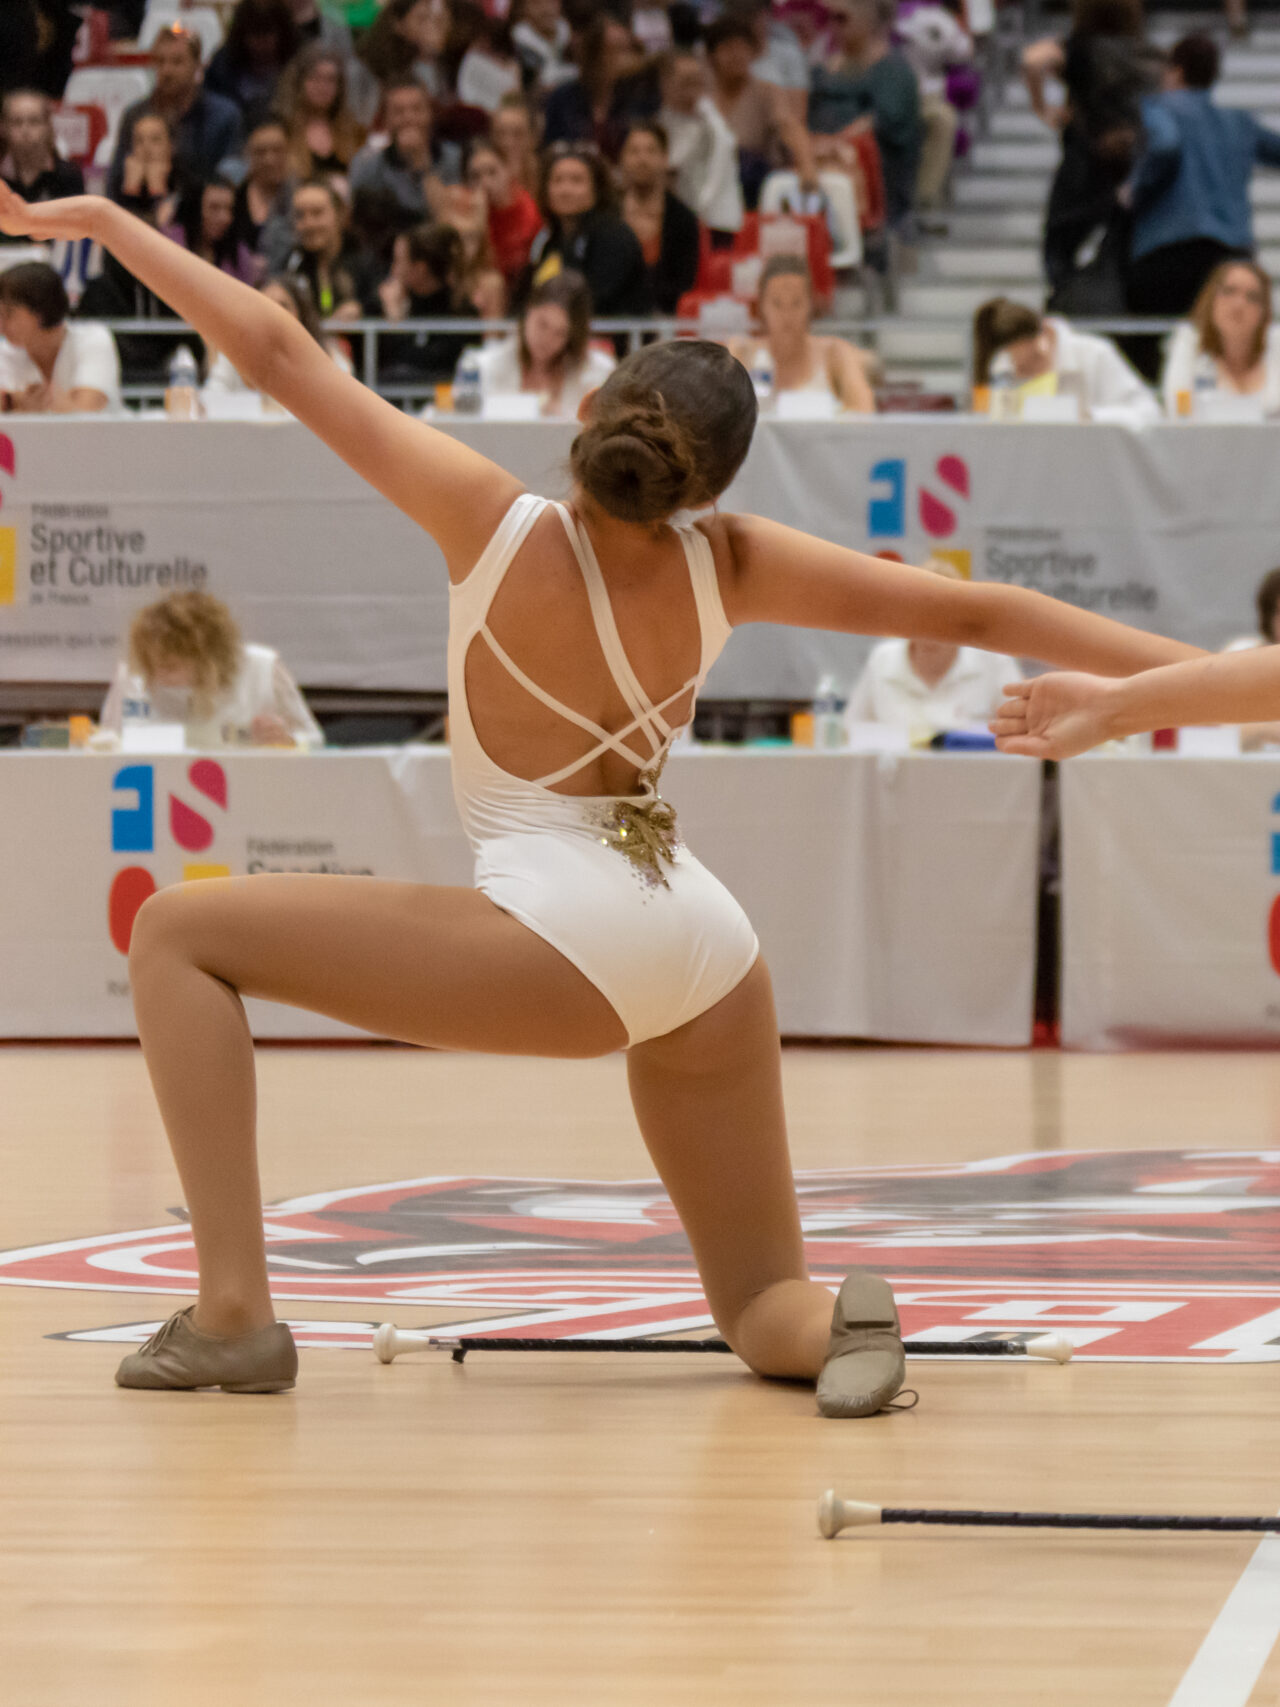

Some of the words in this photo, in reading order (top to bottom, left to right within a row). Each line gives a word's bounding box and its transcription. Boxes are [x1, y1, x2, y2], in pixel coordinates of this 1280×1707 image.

[29, 522, 146, 557] Sportive
[29, 555, 58, 587] et
[68, 556, 208, 588] Culturelle
